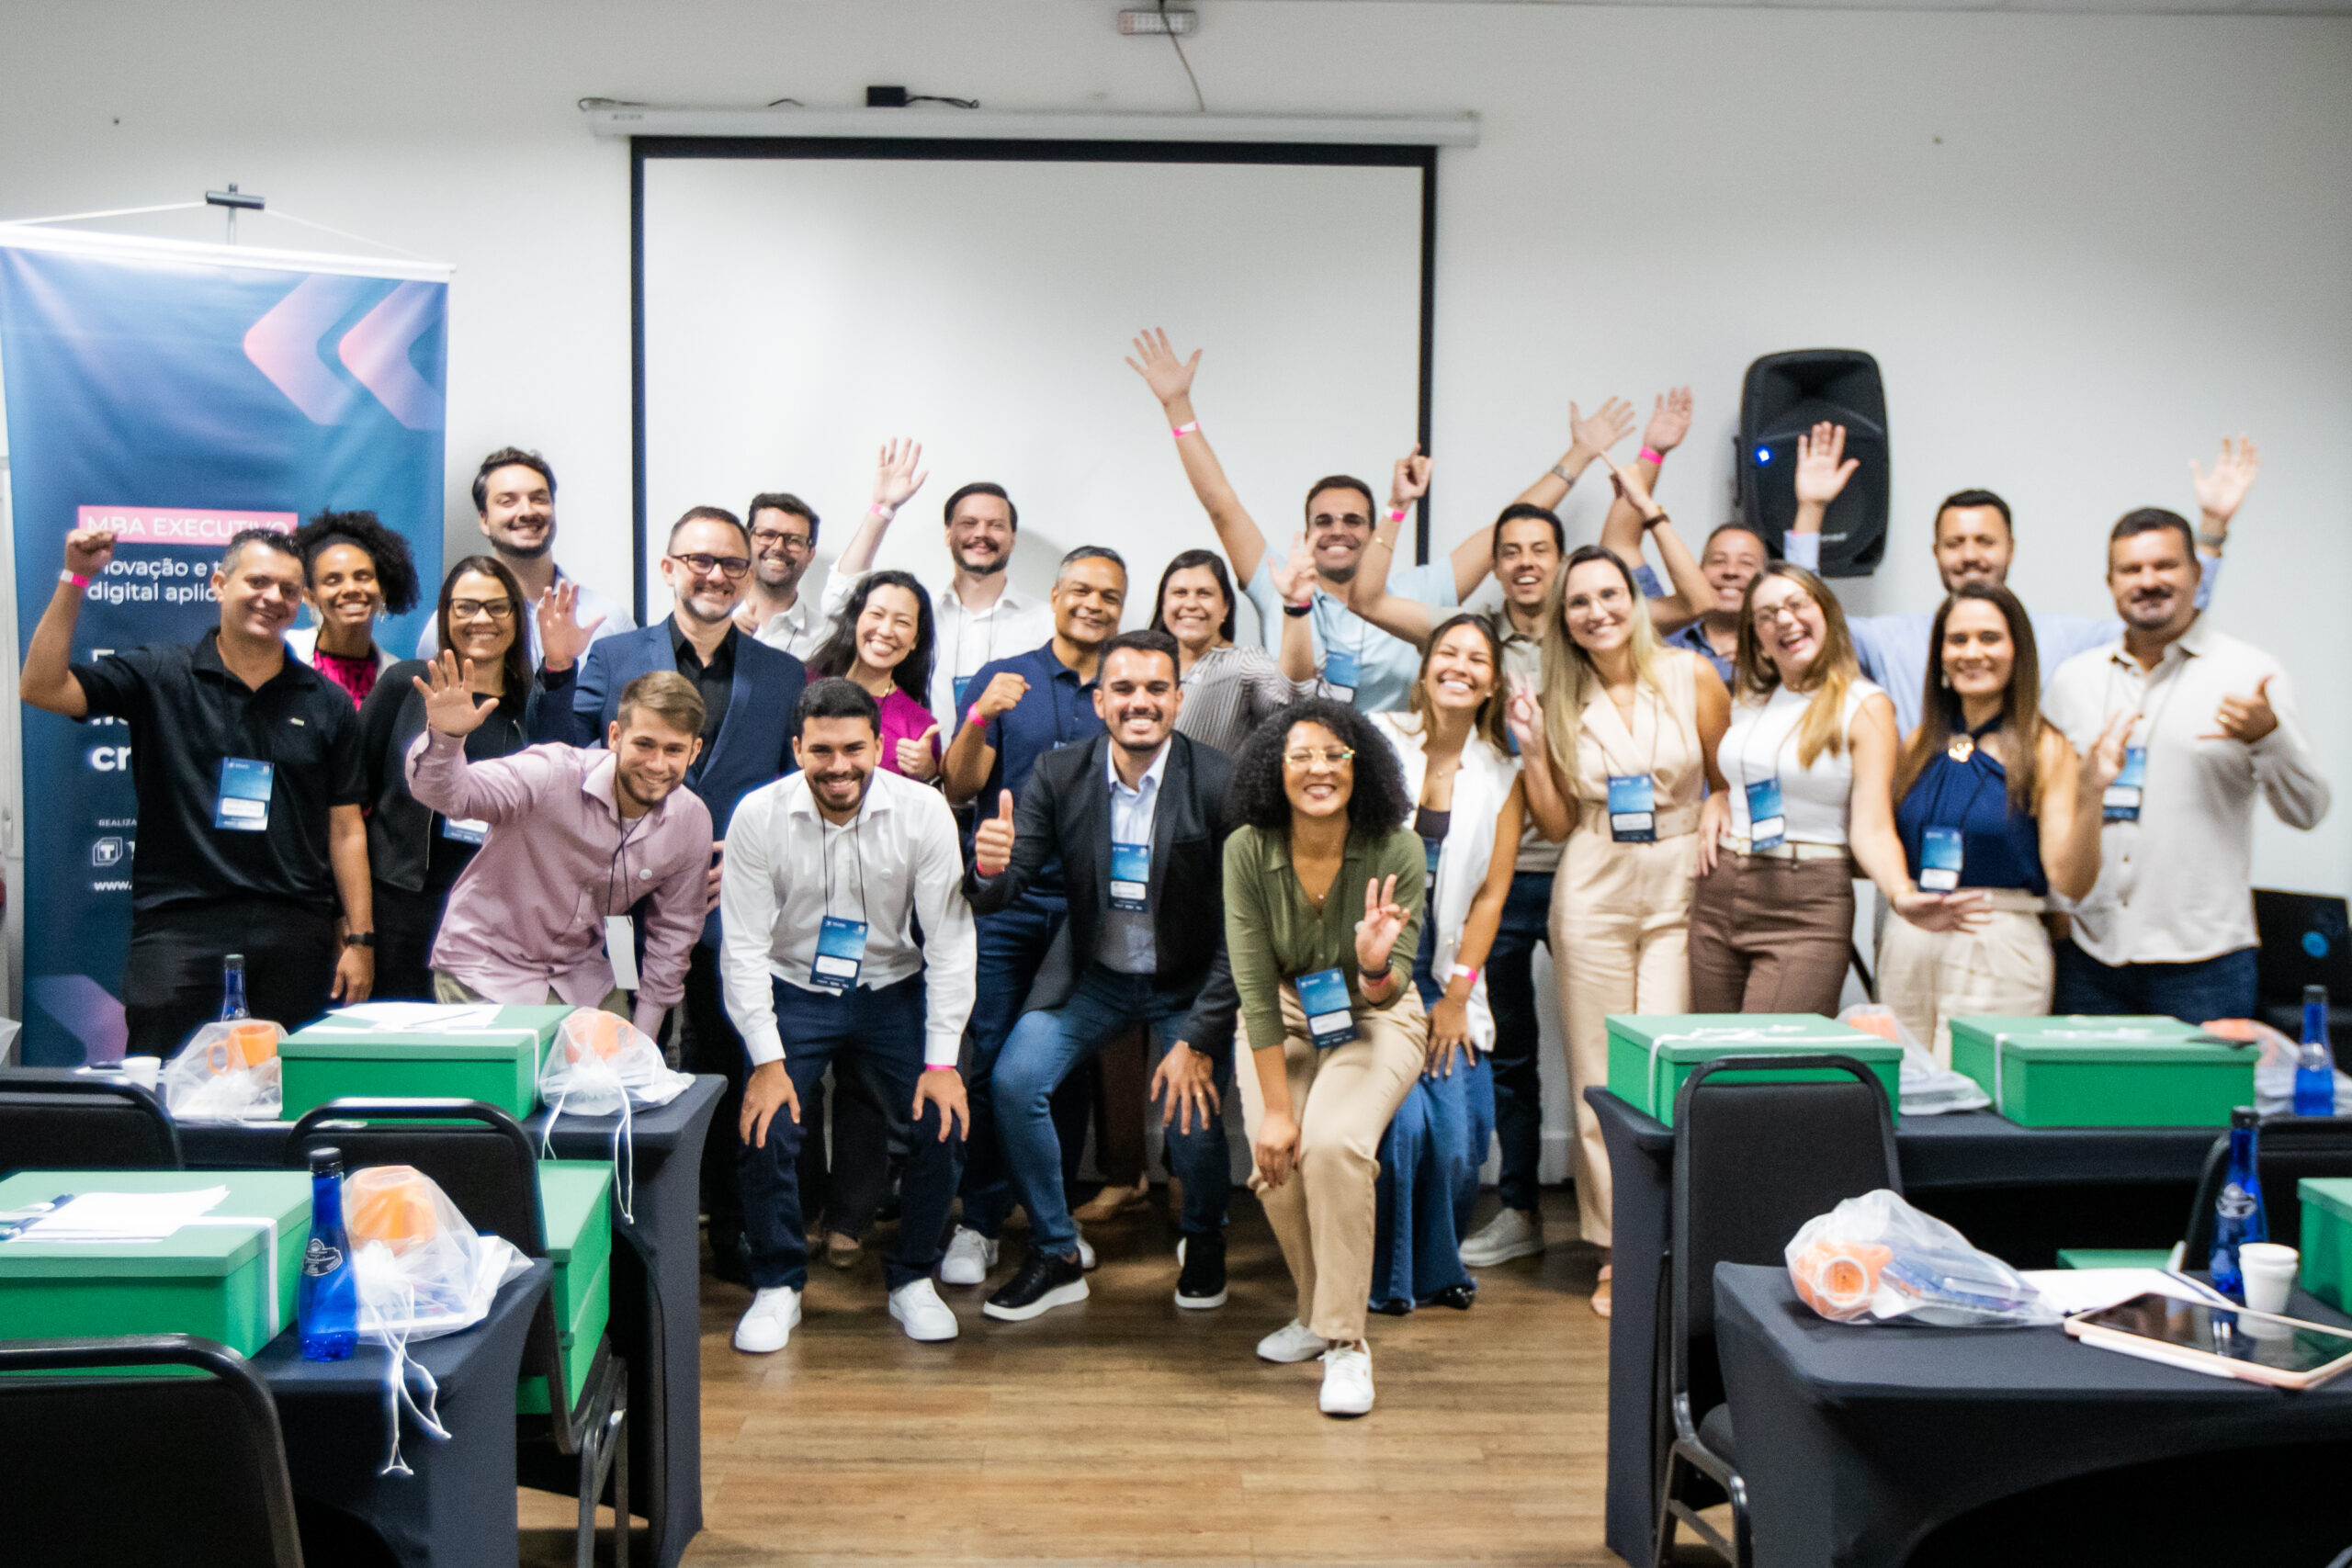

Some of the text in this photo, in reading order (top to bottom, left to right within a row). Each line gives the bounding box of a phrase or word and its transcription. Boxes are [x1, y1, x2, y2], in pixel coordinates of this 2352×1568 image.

[87, 515, 145, 536] MBA
[104, 557, 188, 581] ovação
[194, 561, 208, 577] e
[87, 581, 158, 605] digital
